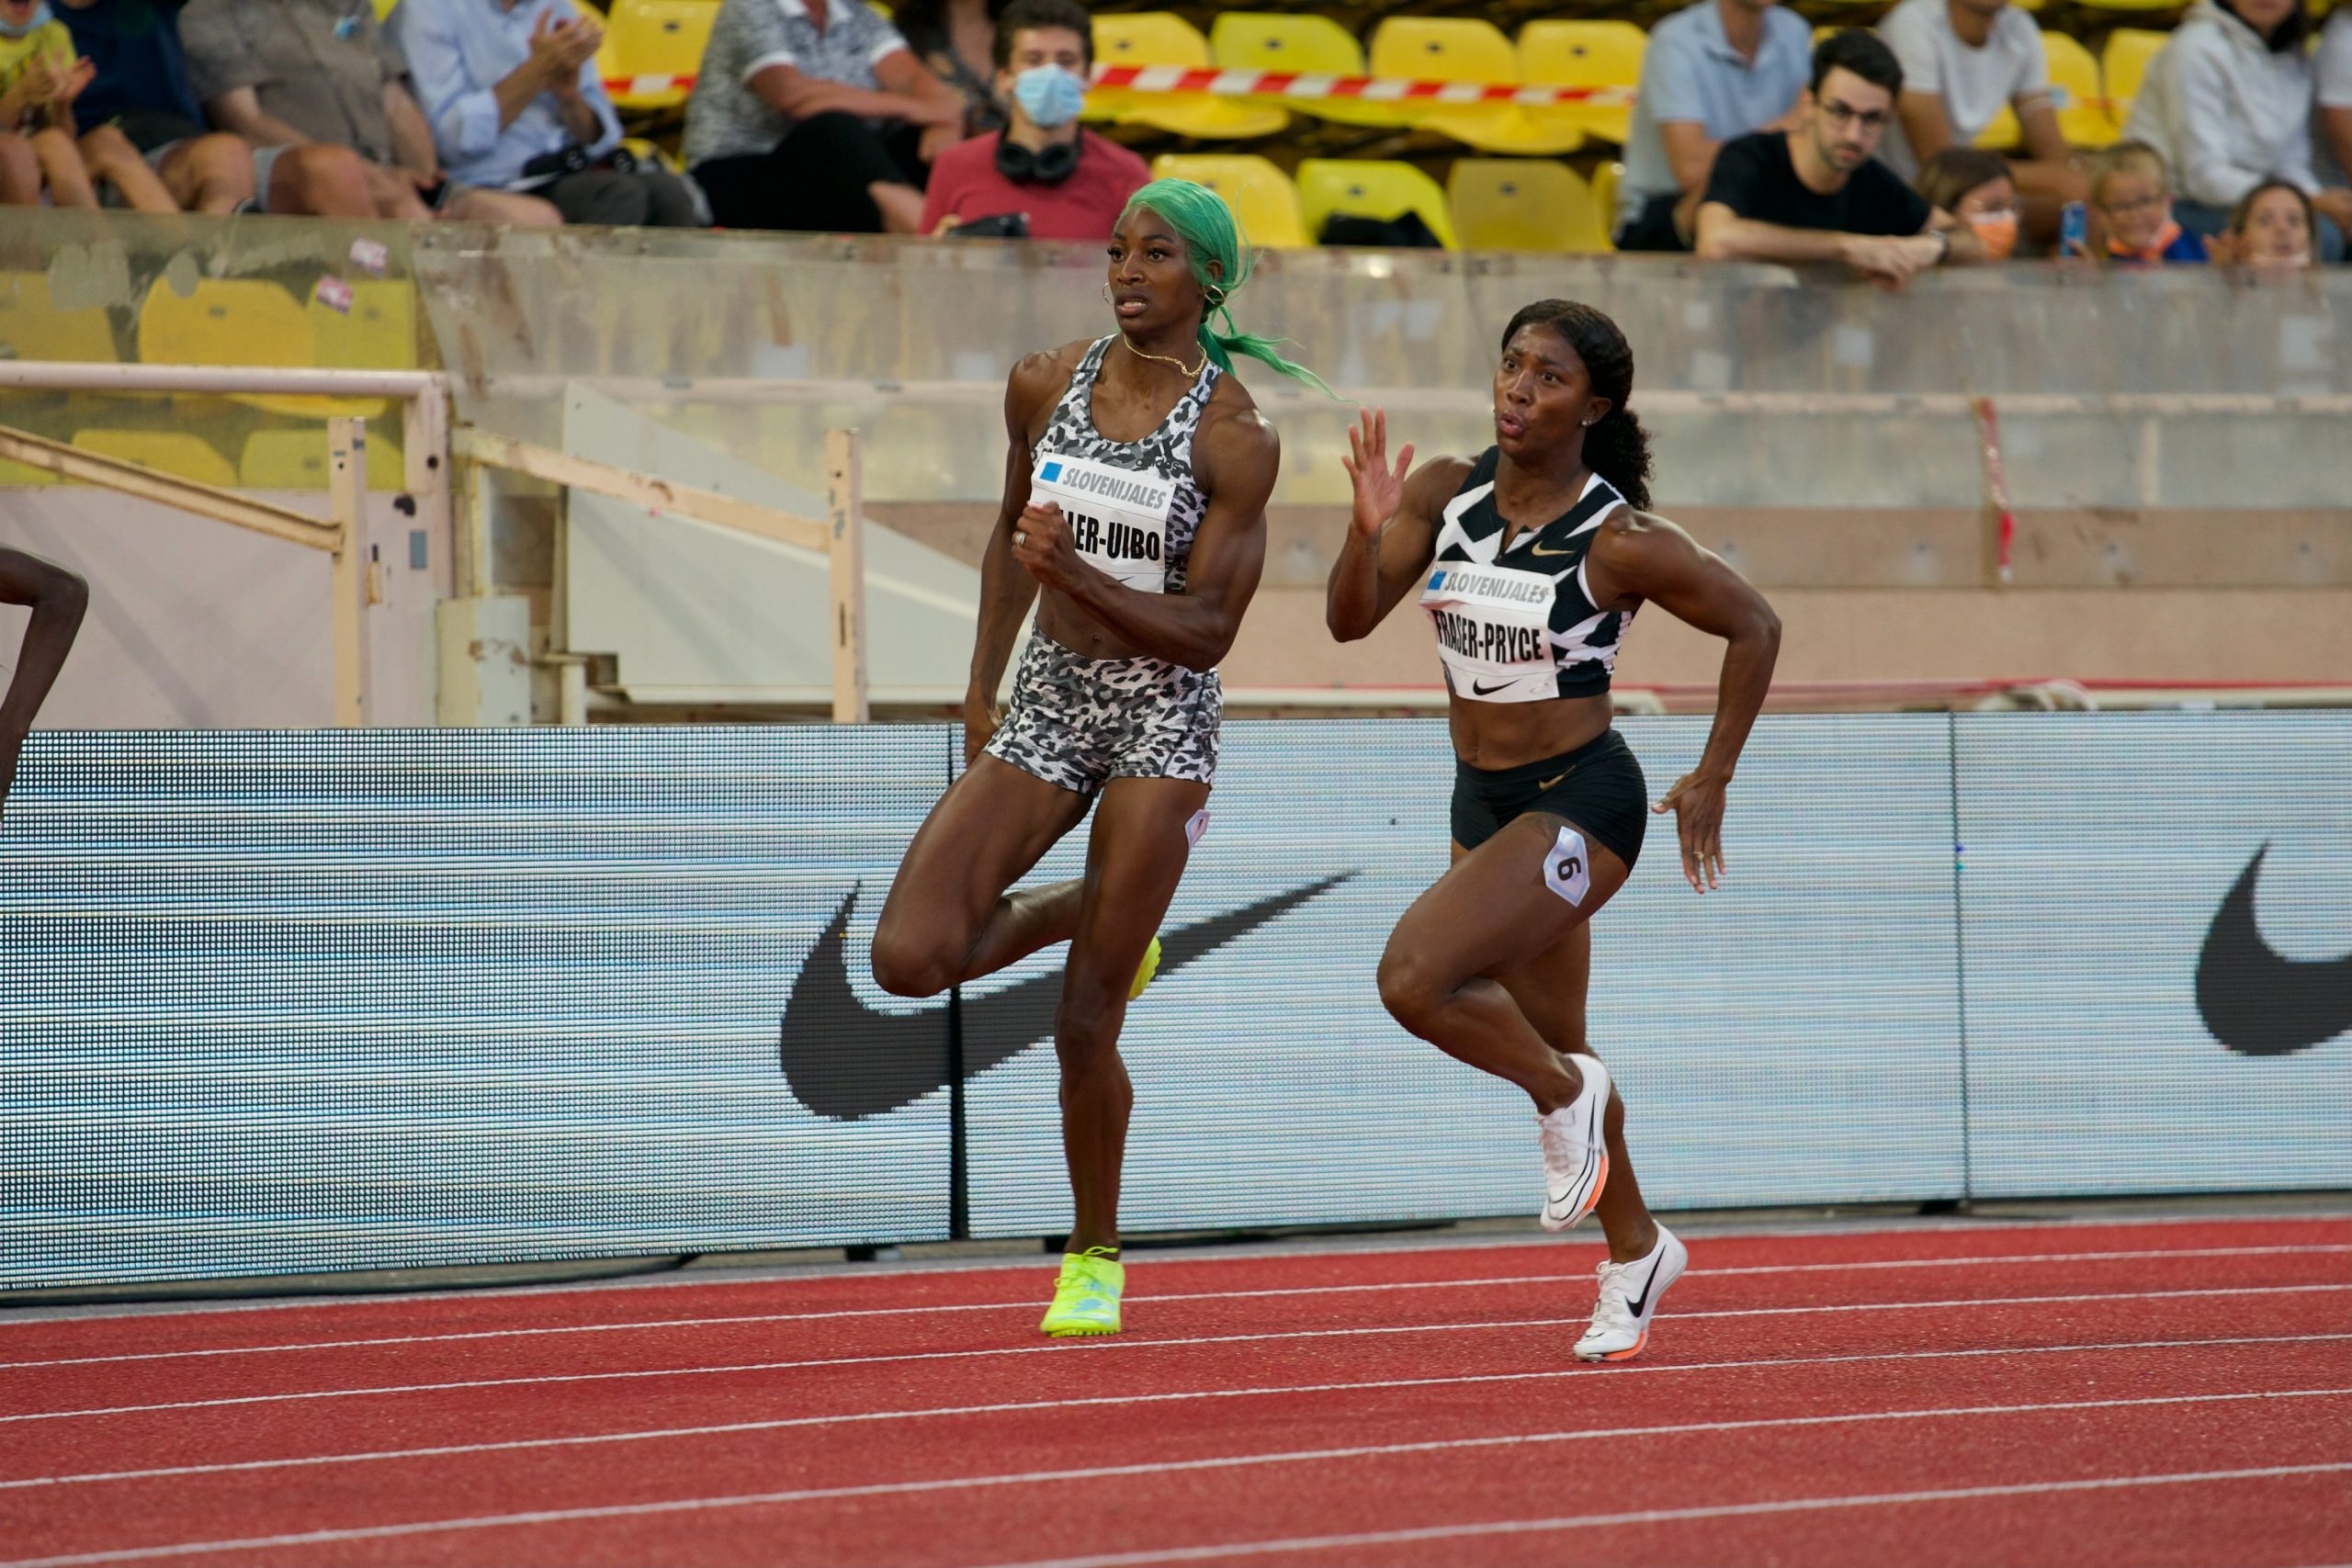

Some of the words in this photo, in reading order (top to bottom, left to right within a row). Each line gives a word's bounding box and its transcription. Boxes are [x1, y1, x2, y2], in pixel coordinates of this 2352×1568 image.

[1063, 468, 1166, 509] SLOVENIJALES
[1060, 510, 1159, 561] ER-UIBO
[1444, 571, 1550, 604] SLOVENIJALES
[1432, 609, 1544, 663] FRASER-PRYCE
[1556, 856, 1581, 882] 6
